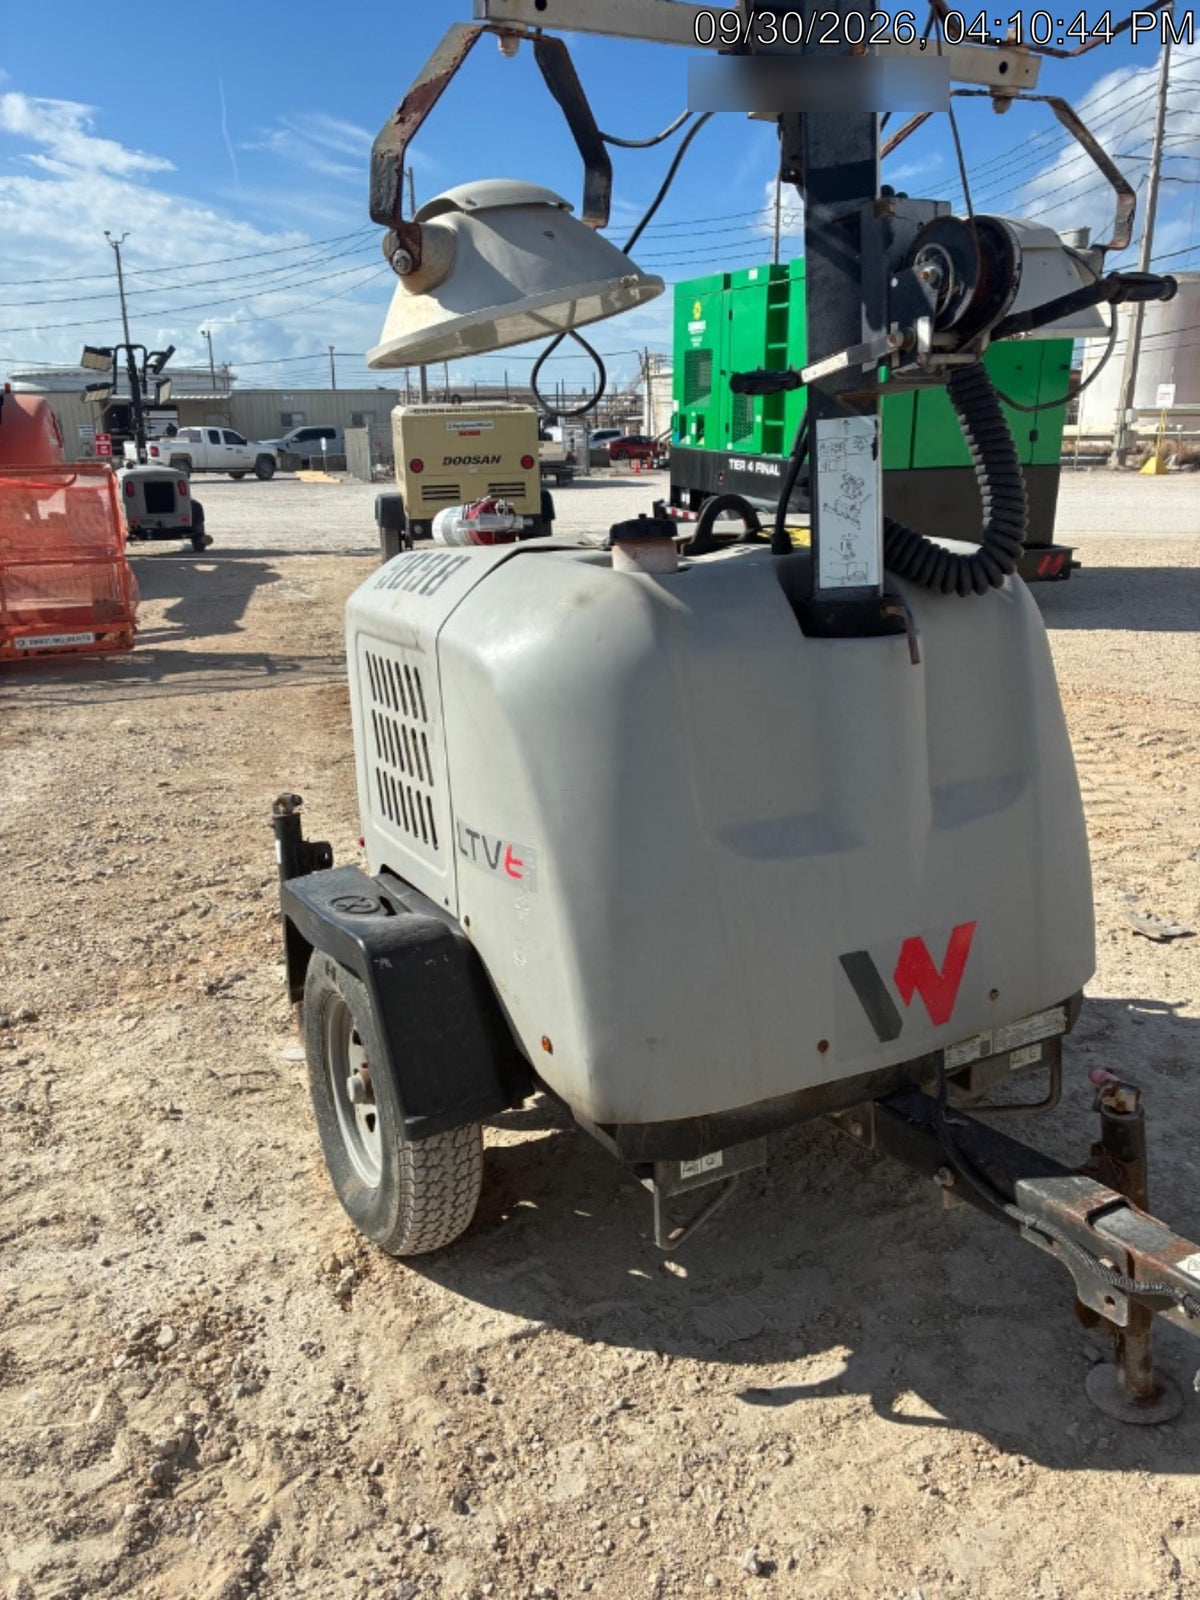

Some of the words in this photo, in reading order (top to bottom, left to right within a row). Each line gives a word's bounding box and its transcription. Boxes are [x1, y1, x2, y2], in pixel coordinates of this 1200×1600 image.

[442, 455, 502, 466] DOOSAN
[728, 458, 746, 471] TIER
[747, 460, 754, 472] 4
[755, 461, 781, 477] FINAL
